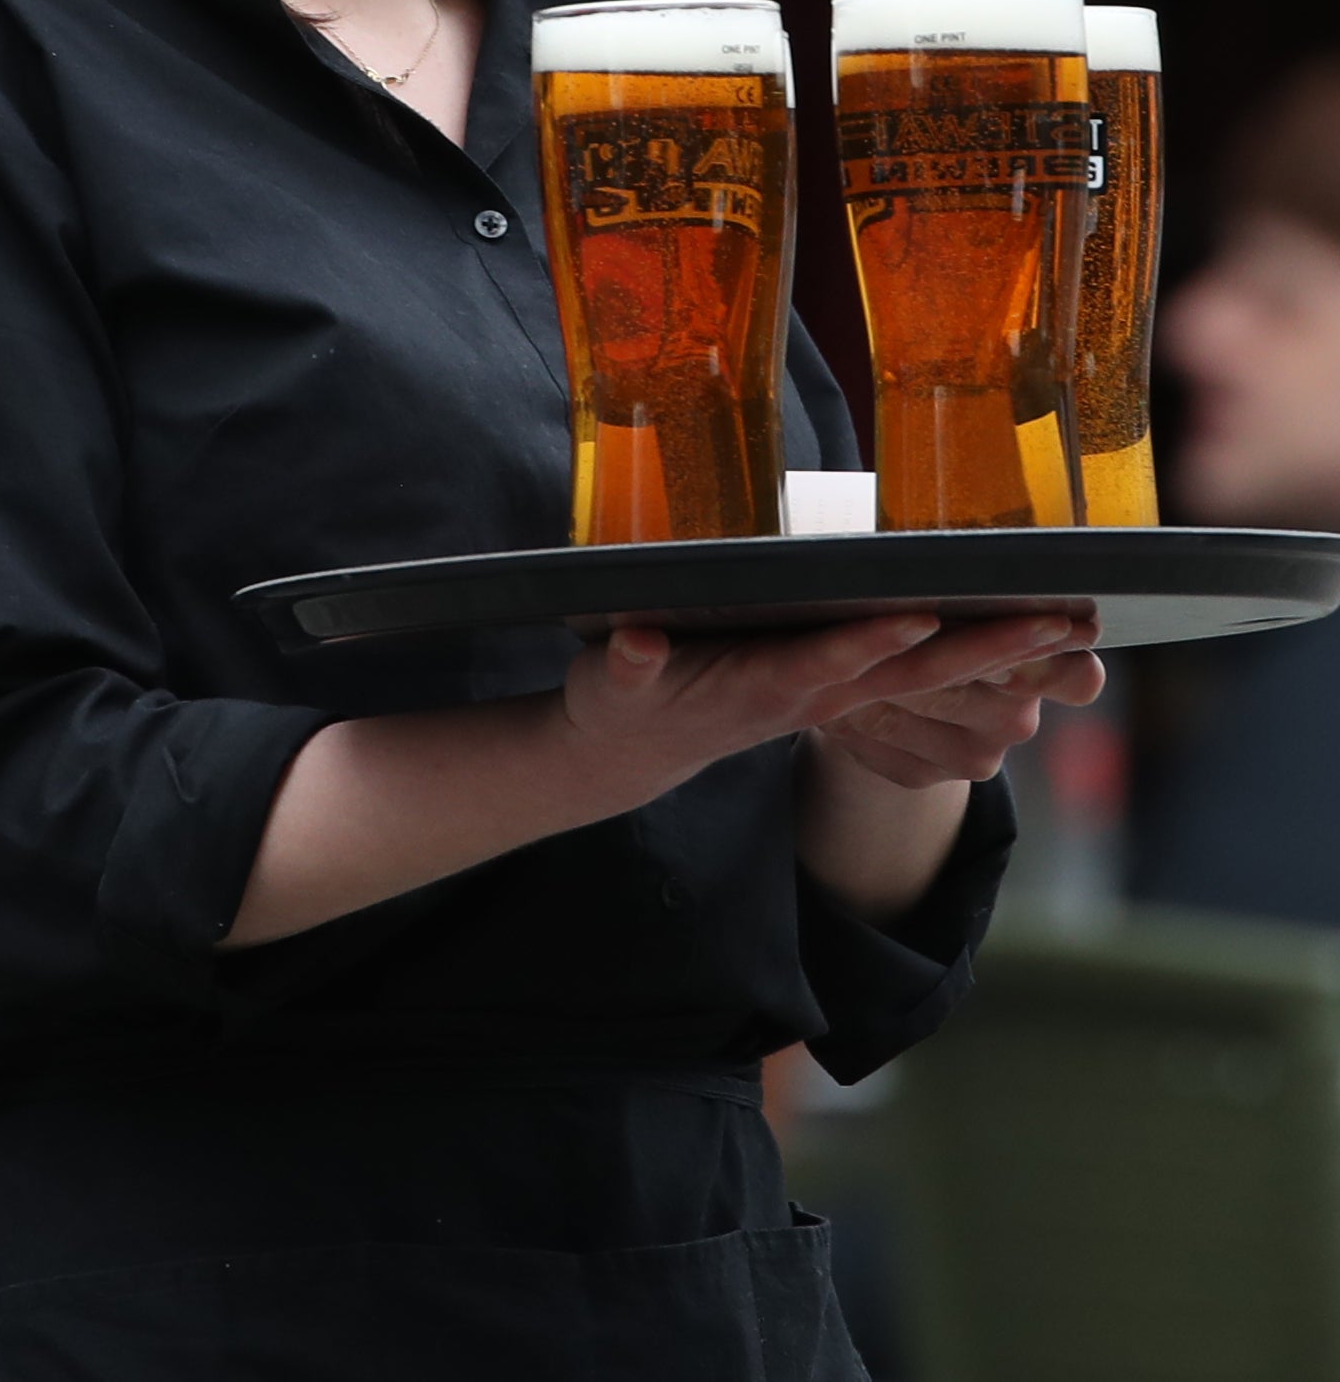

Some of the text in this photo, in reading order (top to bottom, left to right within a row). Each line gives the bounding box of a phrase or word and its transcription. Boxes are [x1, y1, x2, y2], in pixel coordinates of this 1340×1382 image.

[914, 31, 966, 44] ONE PINT
[722, 44, 742, 54] ONE
